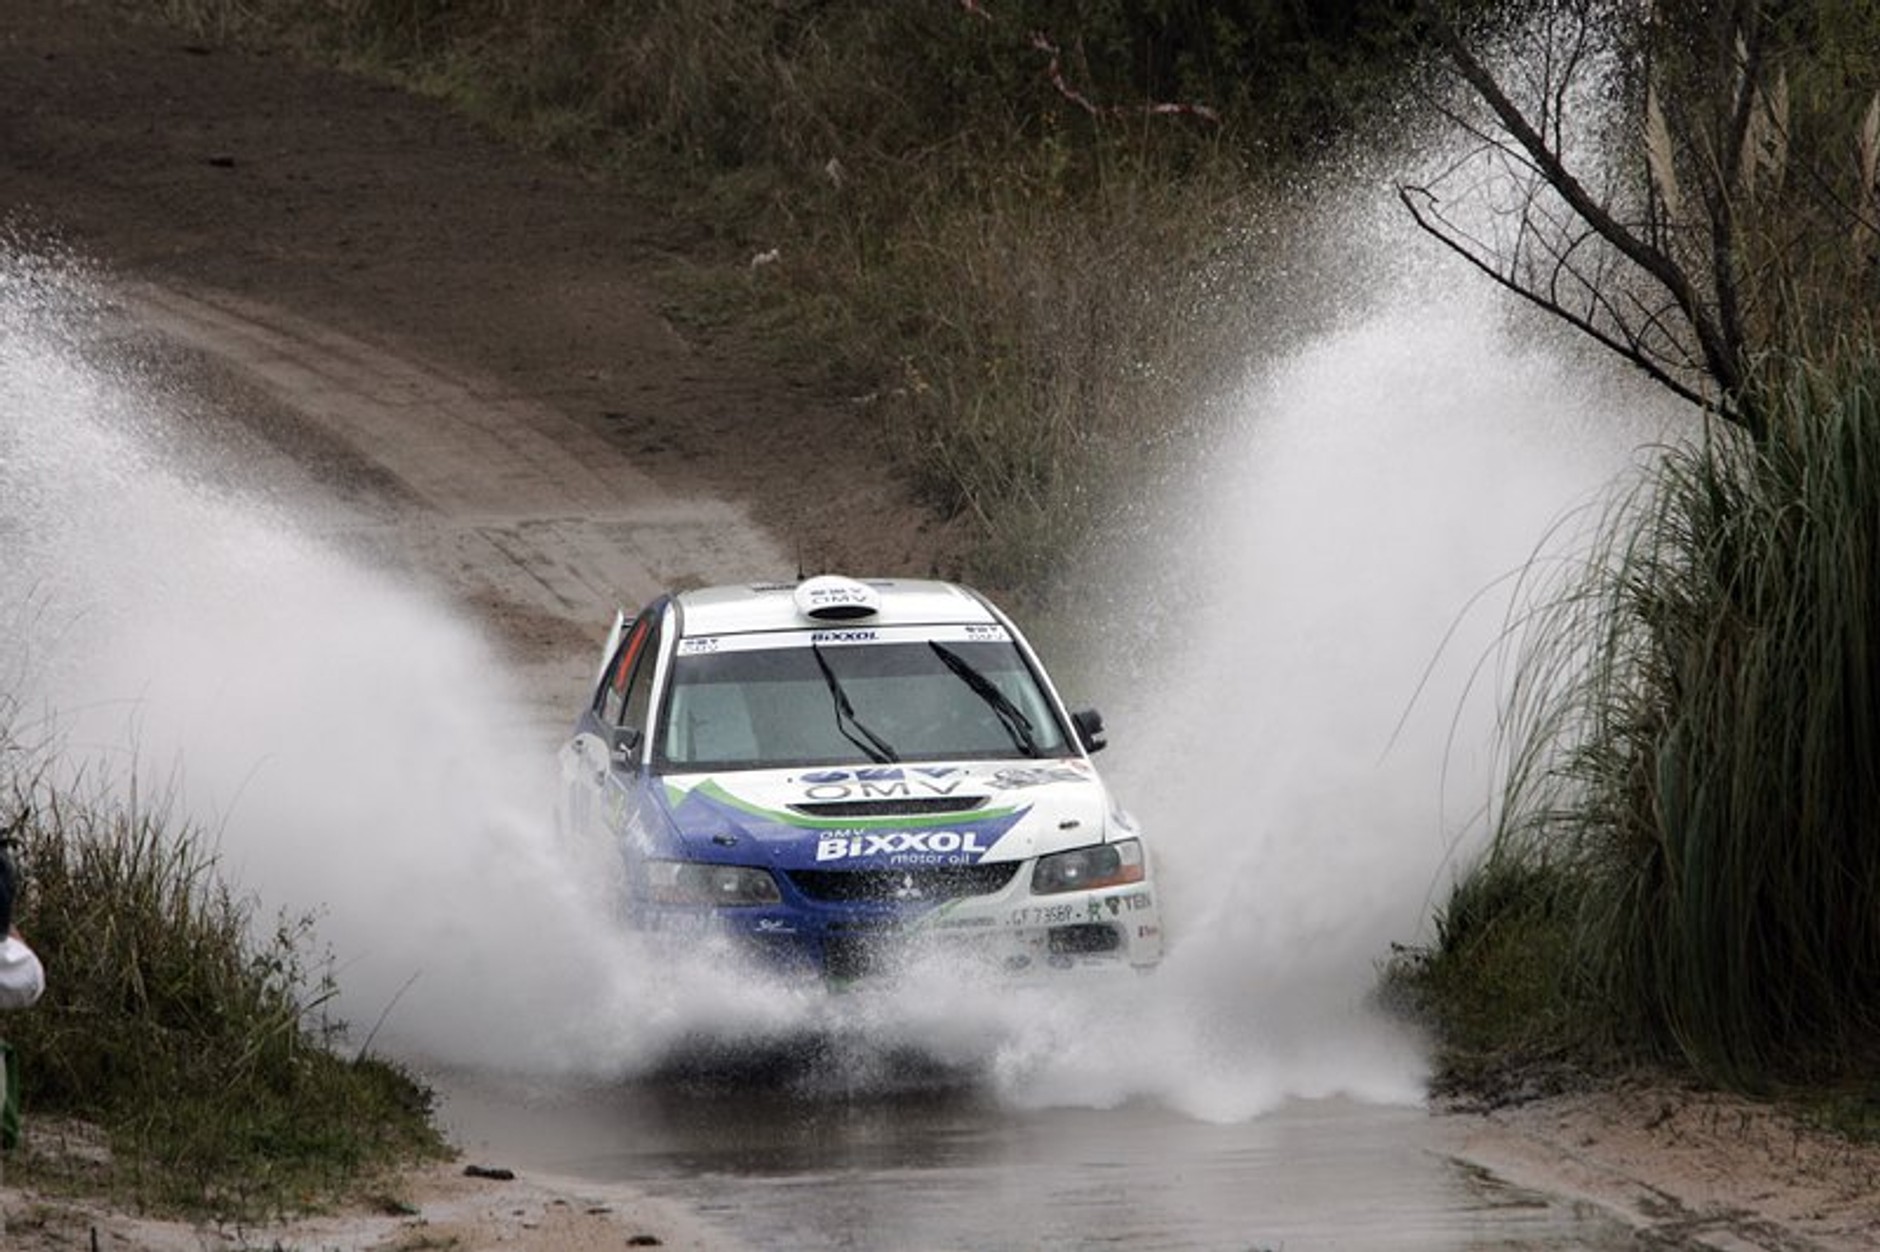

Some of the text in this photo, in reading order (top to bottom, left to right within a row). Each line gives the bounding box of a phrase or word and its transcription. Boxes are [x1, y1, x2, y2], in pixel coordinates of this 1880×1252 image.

[804, 780, 961, 800] OMV
[890, 852, 970, 865] motor oil
